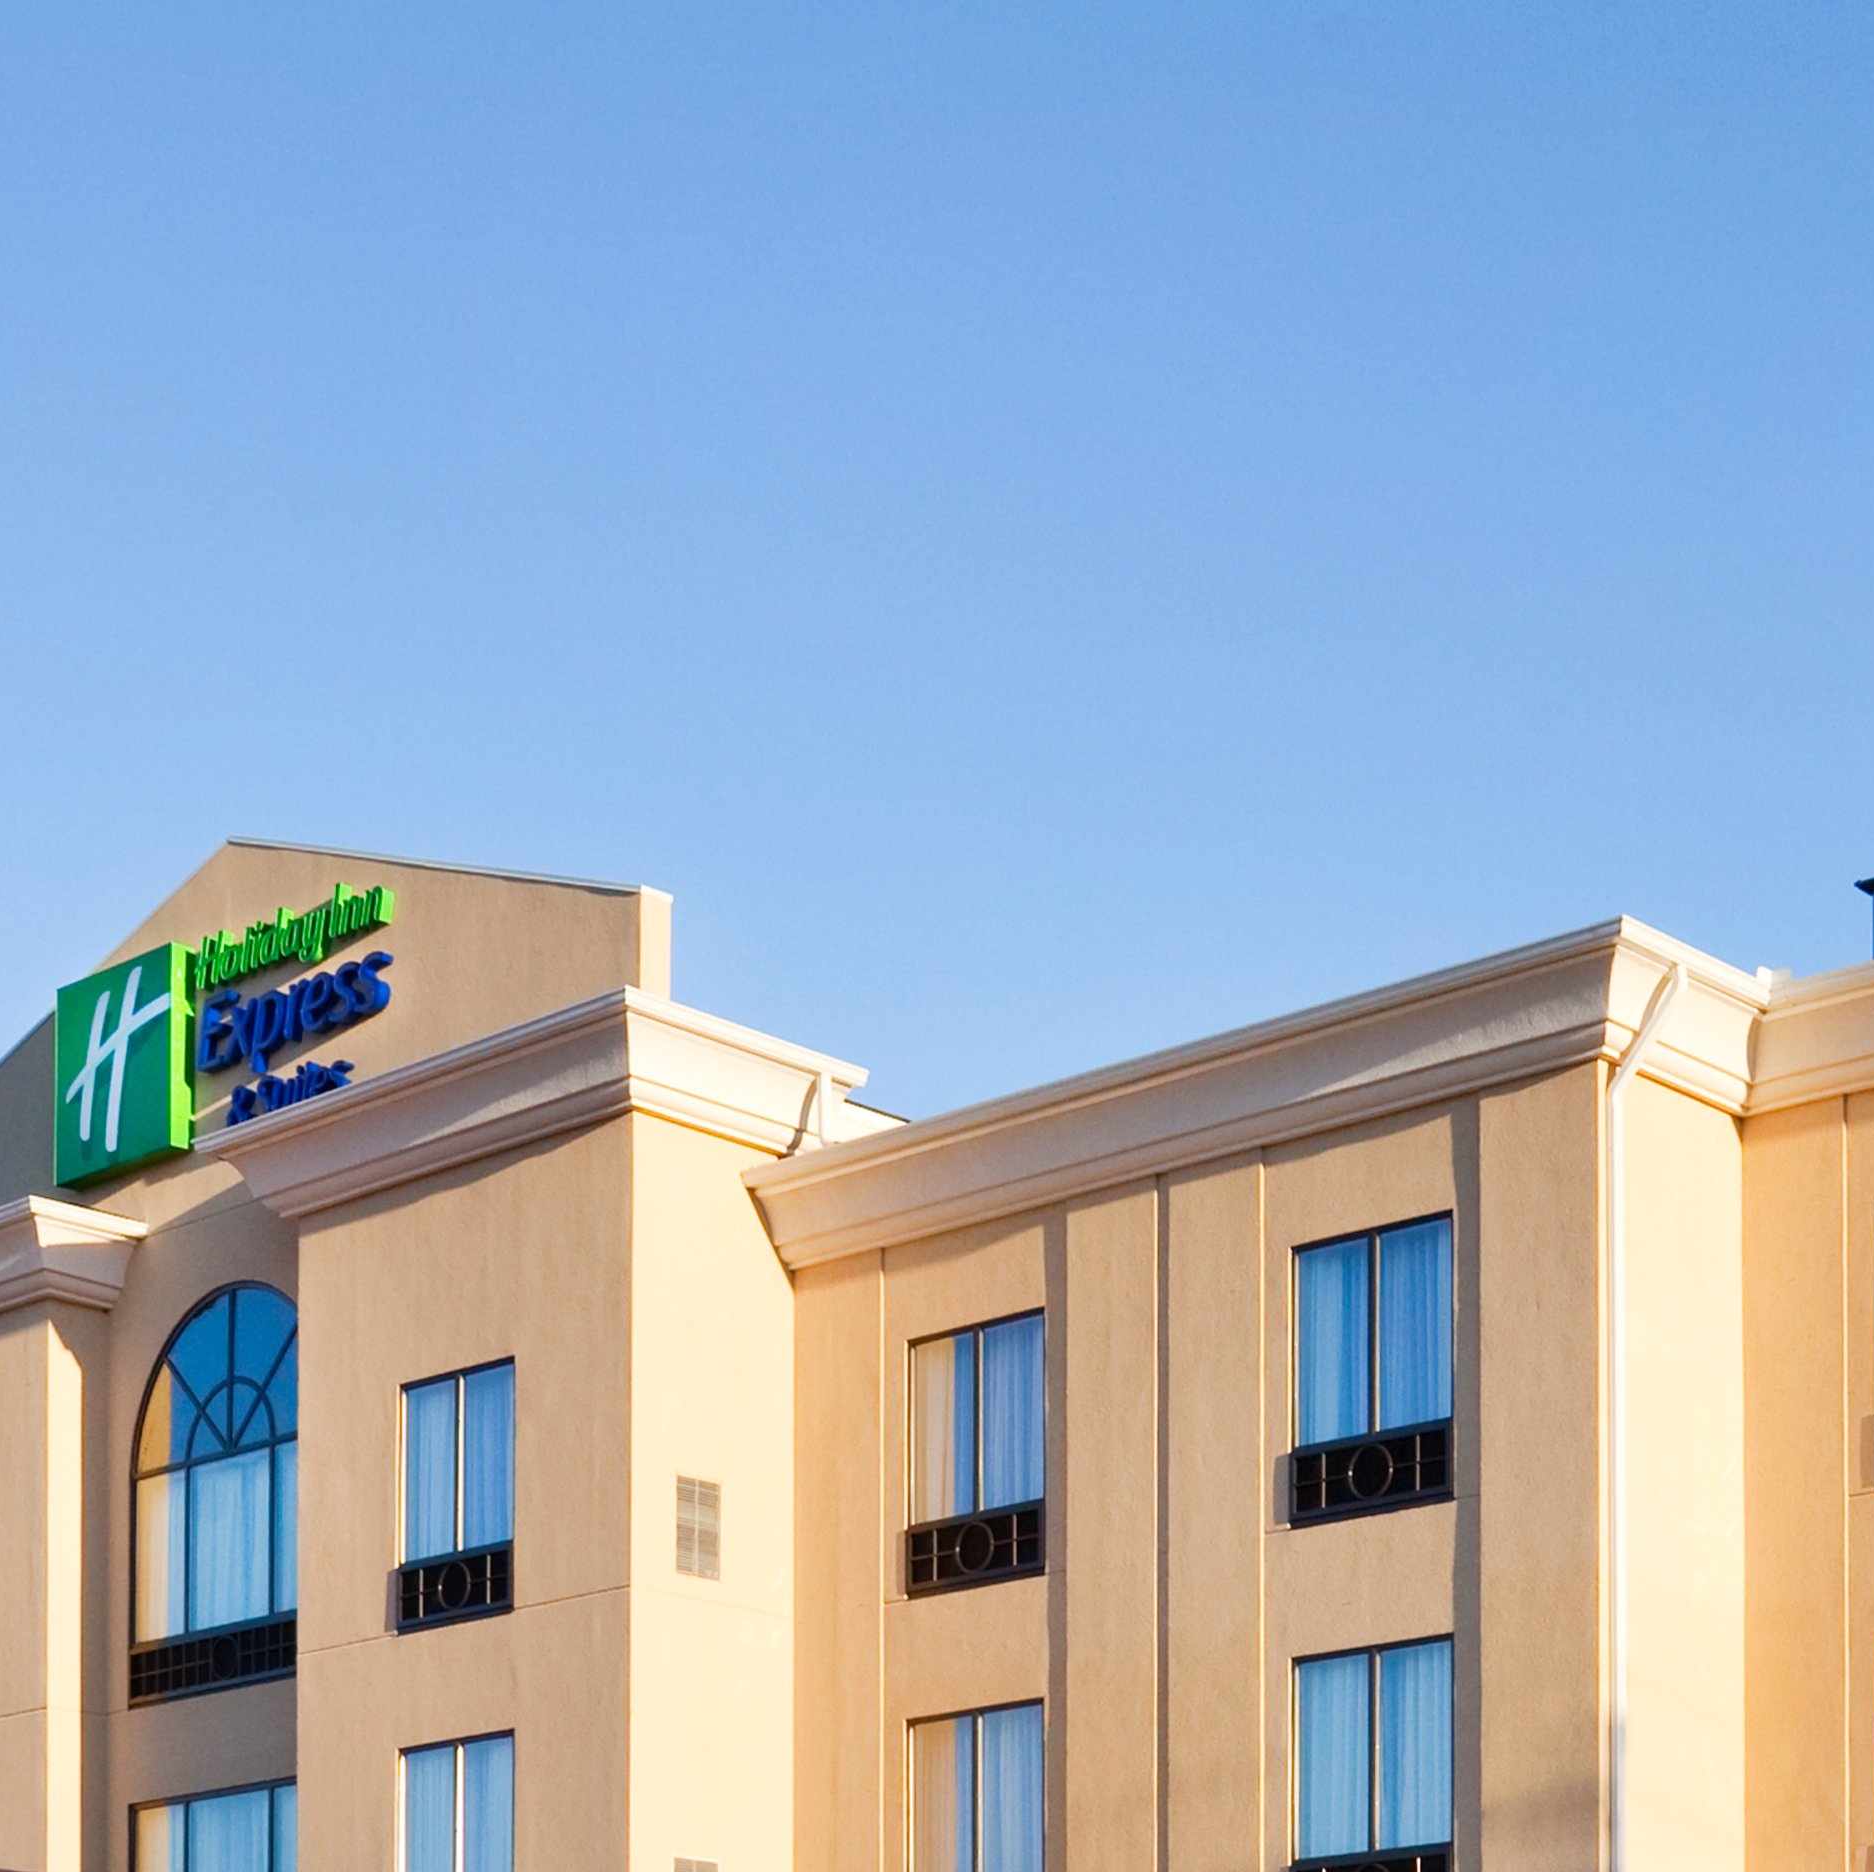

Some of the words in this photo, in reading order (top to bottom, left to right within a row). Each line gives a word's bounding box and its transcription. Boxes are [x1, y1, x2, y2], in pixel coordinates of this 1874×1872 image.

[195, 907, 326, 990] Holiday
[329, 882, 395, 938] Inn
[195, 951, 394, 1074] Express
